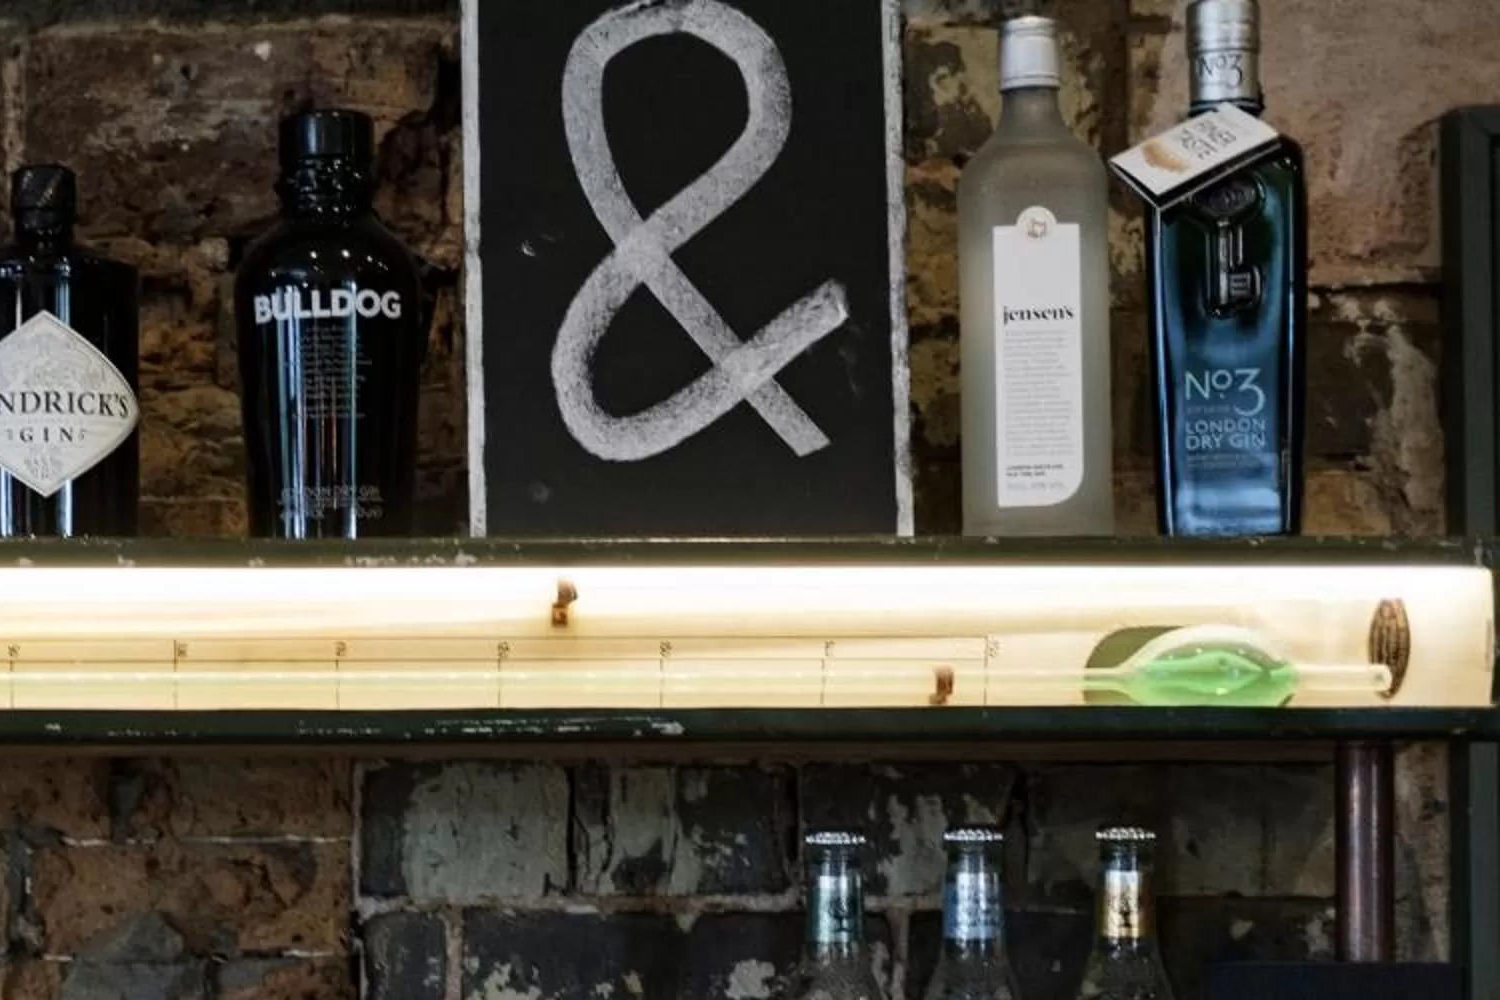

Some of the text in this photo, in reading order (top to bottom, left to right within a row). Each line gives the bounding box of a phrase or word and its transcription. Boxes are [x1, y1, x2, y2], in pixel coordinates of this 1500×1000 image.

[551, 0, 849, 462] &
[253, 288, 402, 326] BULLDOG
[19, 427, 74, 443] GIN
[1185, 418, 1266, 435] LONDON
[1185, 432, 1266, 451] DRY GIN
